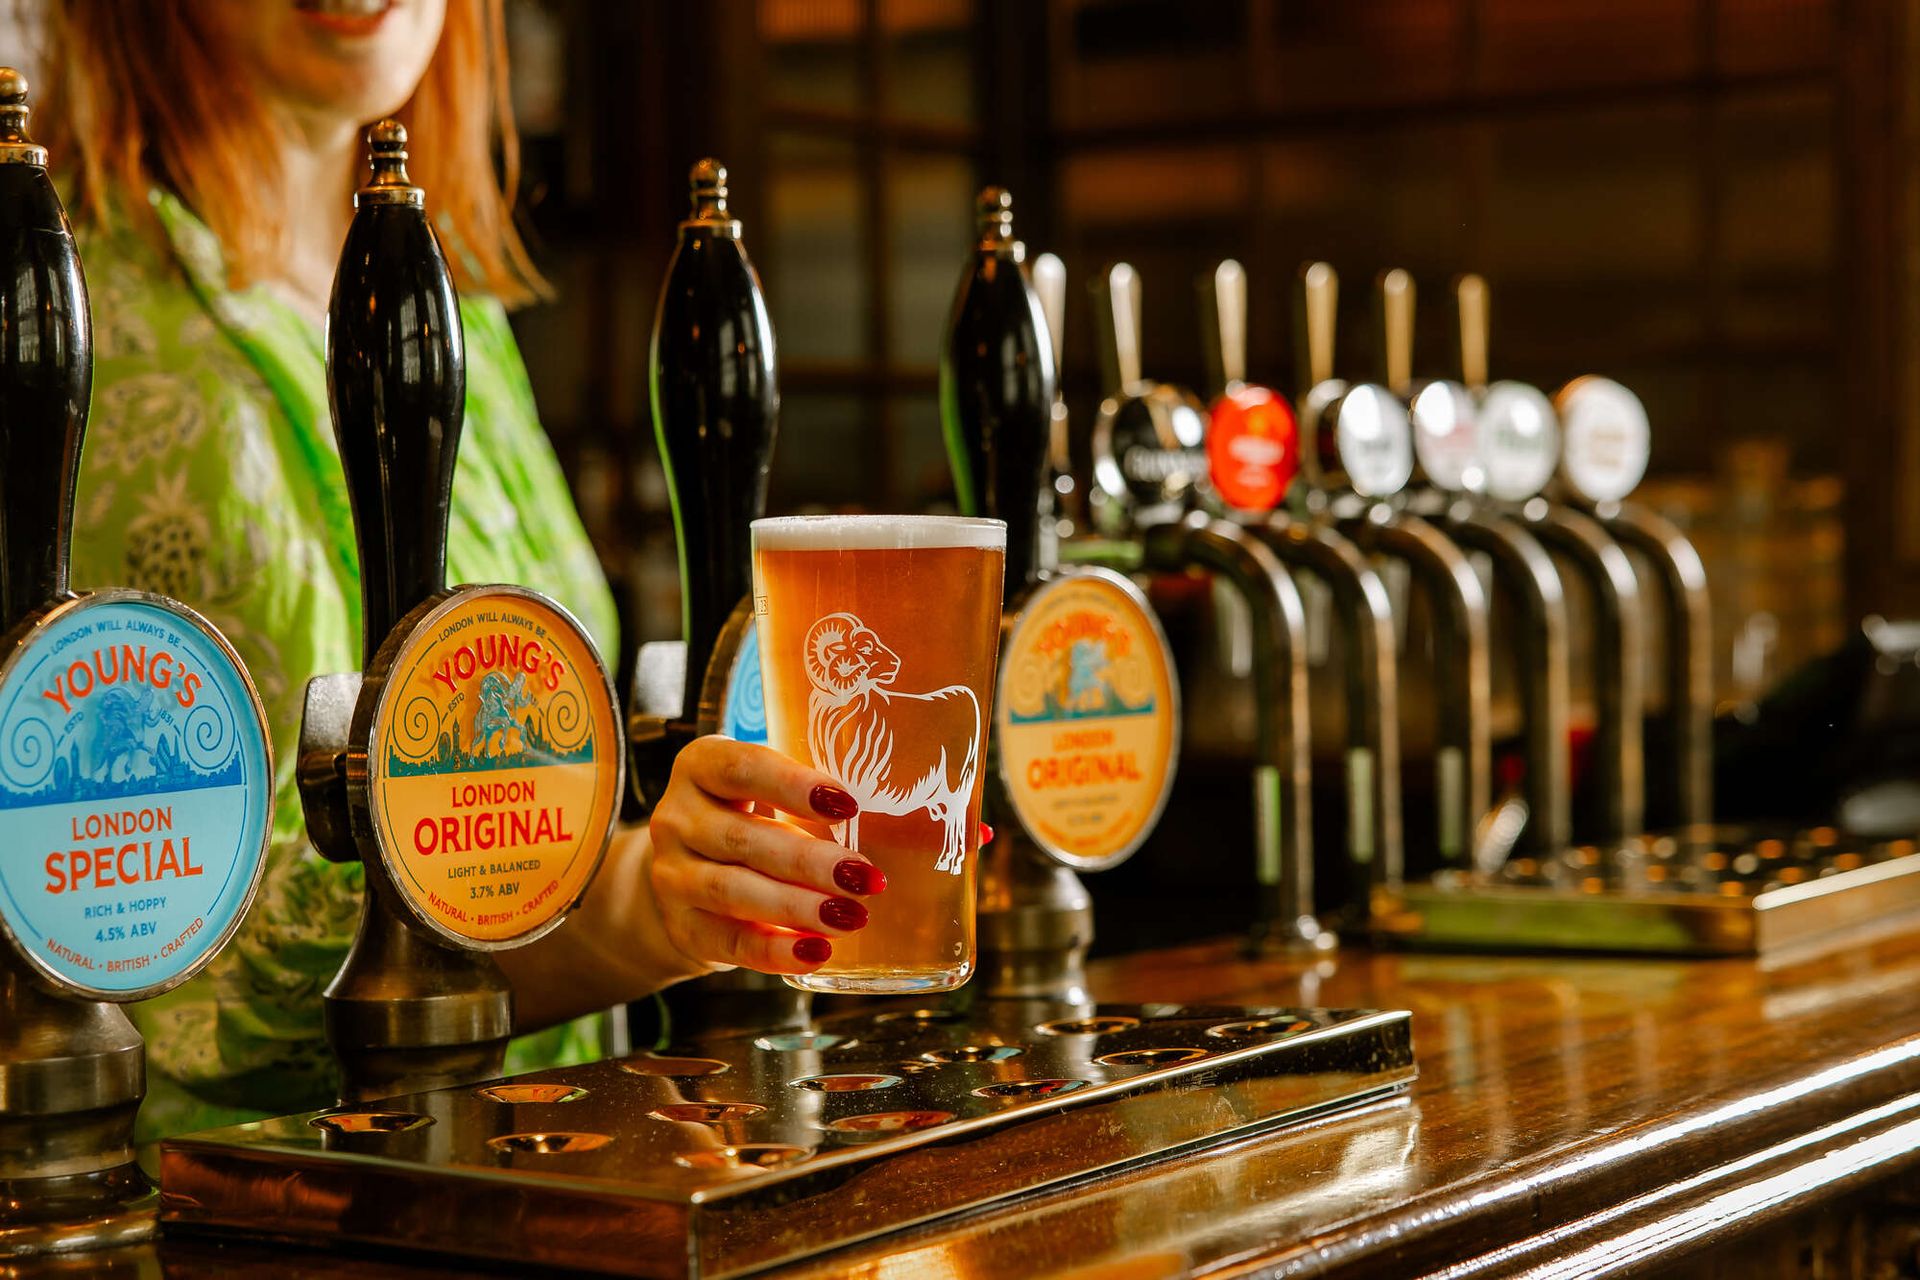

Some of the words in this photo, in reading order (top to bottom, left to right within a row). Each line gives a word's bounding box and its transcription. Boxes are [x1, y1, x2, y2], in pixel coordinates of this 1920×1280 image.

[51, 624, 93, 654] LONDON
[96, 619, 122, 631] WILL
[126, 620, 165, 639] ALWAYS
[167, 633, 181, 646] BE
[438, 616, 474, 642] LONDON
[477, 612, 498, 624] WILL
[501, 613, 533, 631] ALWAYS
[535, 625, 547, 639] BE
[42, 644, 203, 714] YOUNG'S
[433, 633, 566, 694] YOUNG'S
[448, 691, 465, 713] ESTD
[64, 711, 84, 735] ESTD
[158, 708, 174, 725] 1831
[1026, 751, 1142, 792] ORIGINAL
[452, 780, 535, 808] LONDON
[72, 806, 172, 841] LONDON
[414, 807, 573, 856] ORIGINAL
[44, 837, 203, 894] SPECIAL
[448, 866, 476, 879] LIGHT
[480, 865, 486, 876] &
[490, 860, 540, 874] BALANCED
[84, 904, 112, 919] RICH
[116, 902, 125, 914] &
[129, 896, 167, 913] HOPPY
[428, 891, 467, 923] NATURAL
[477, 911, 513, 926] BRITISH
[522, 879, 559, 915] CRAFTED
[470, 886, 494, 899] 3.7%
[498, 882, 520, 897] ABV
[47, 937, 95, 971] NATURAL
[106, 955, 150, 972] BRITISH
[160, 917, 204, 958] CRAFTED
[95, 925, 125, 942] 4.5%
[130, 921, 157, 938] ABV
